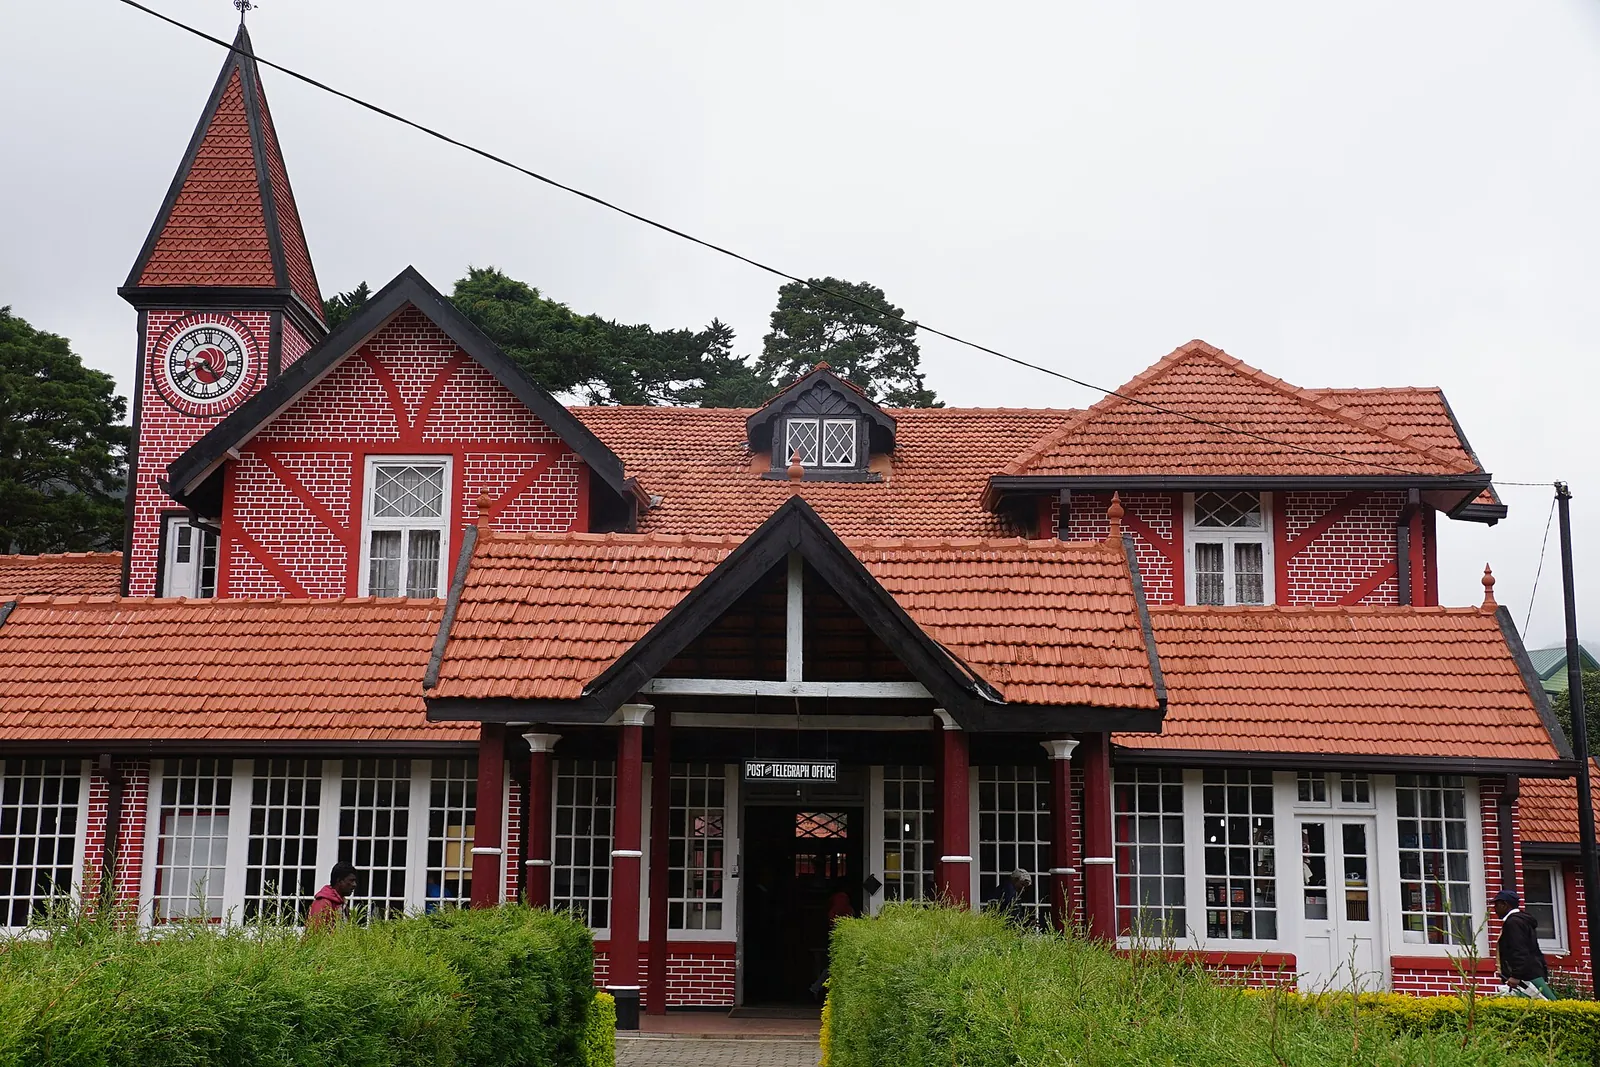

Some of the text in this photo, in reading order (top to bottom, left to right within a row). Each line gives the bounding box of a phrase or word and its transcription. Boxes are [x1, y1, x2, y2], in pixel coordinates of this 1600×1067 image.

[746, 764, 765, 777] POST
[772, 764, 810, 778] TELEGRAPH
[811, 765, 835, 778] OFFICE
